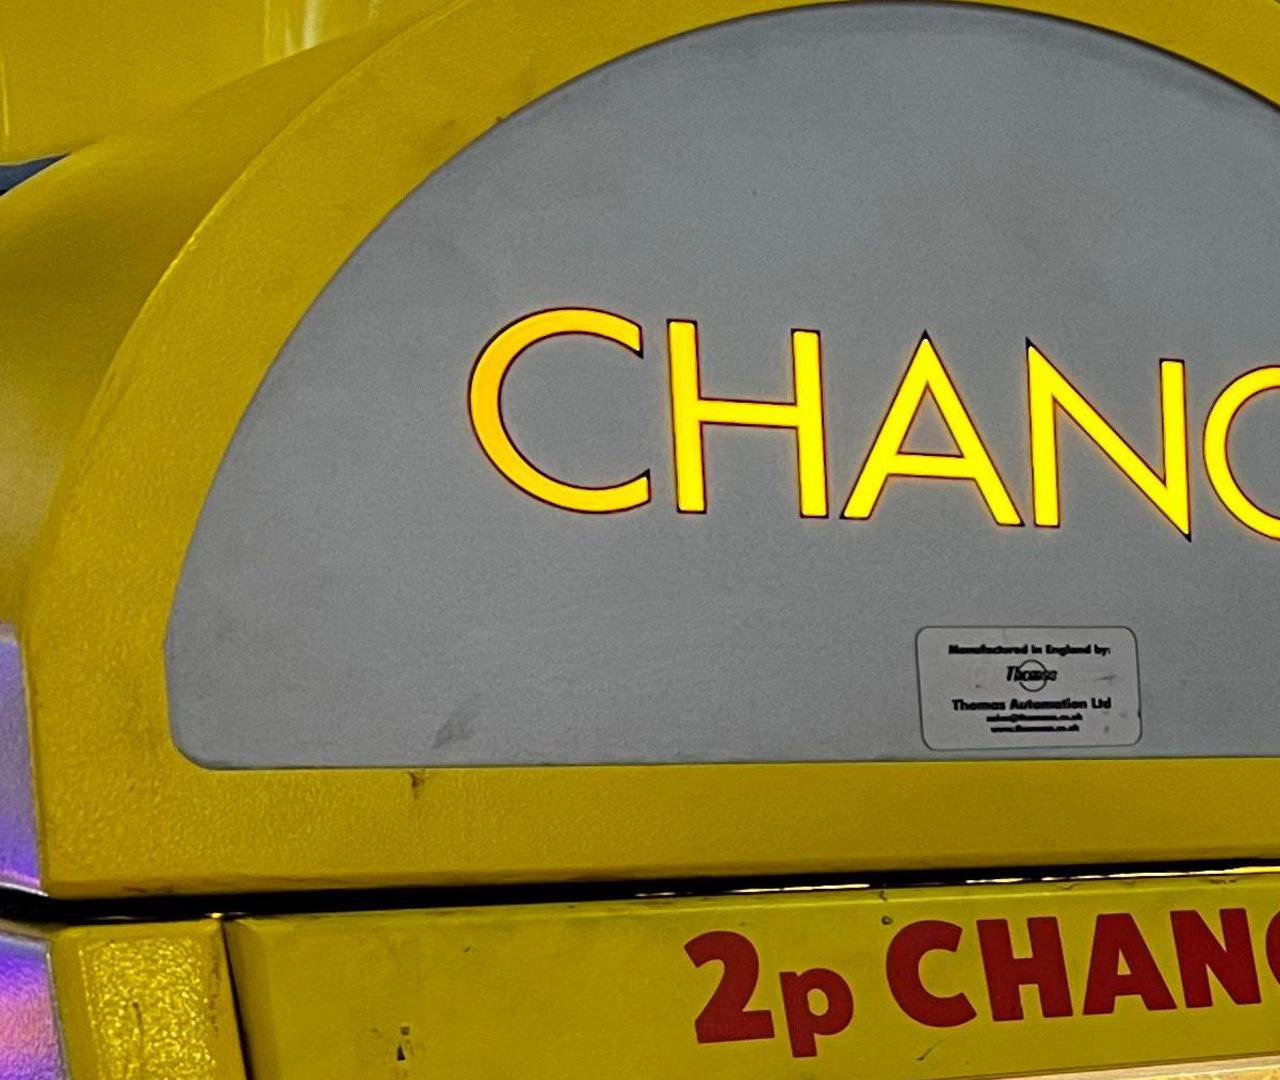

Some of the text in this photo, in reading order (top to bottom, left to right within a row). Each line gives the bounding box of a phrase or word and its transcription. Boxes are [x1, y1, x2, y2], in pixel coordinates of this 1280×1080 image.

[1031, 645, 1042, 654] in
[1045, 644, 1091, 656] England
[952, 697, 1112, 710] Thomas Automation Ltd
[684, 930, 855, 1058] 2p
